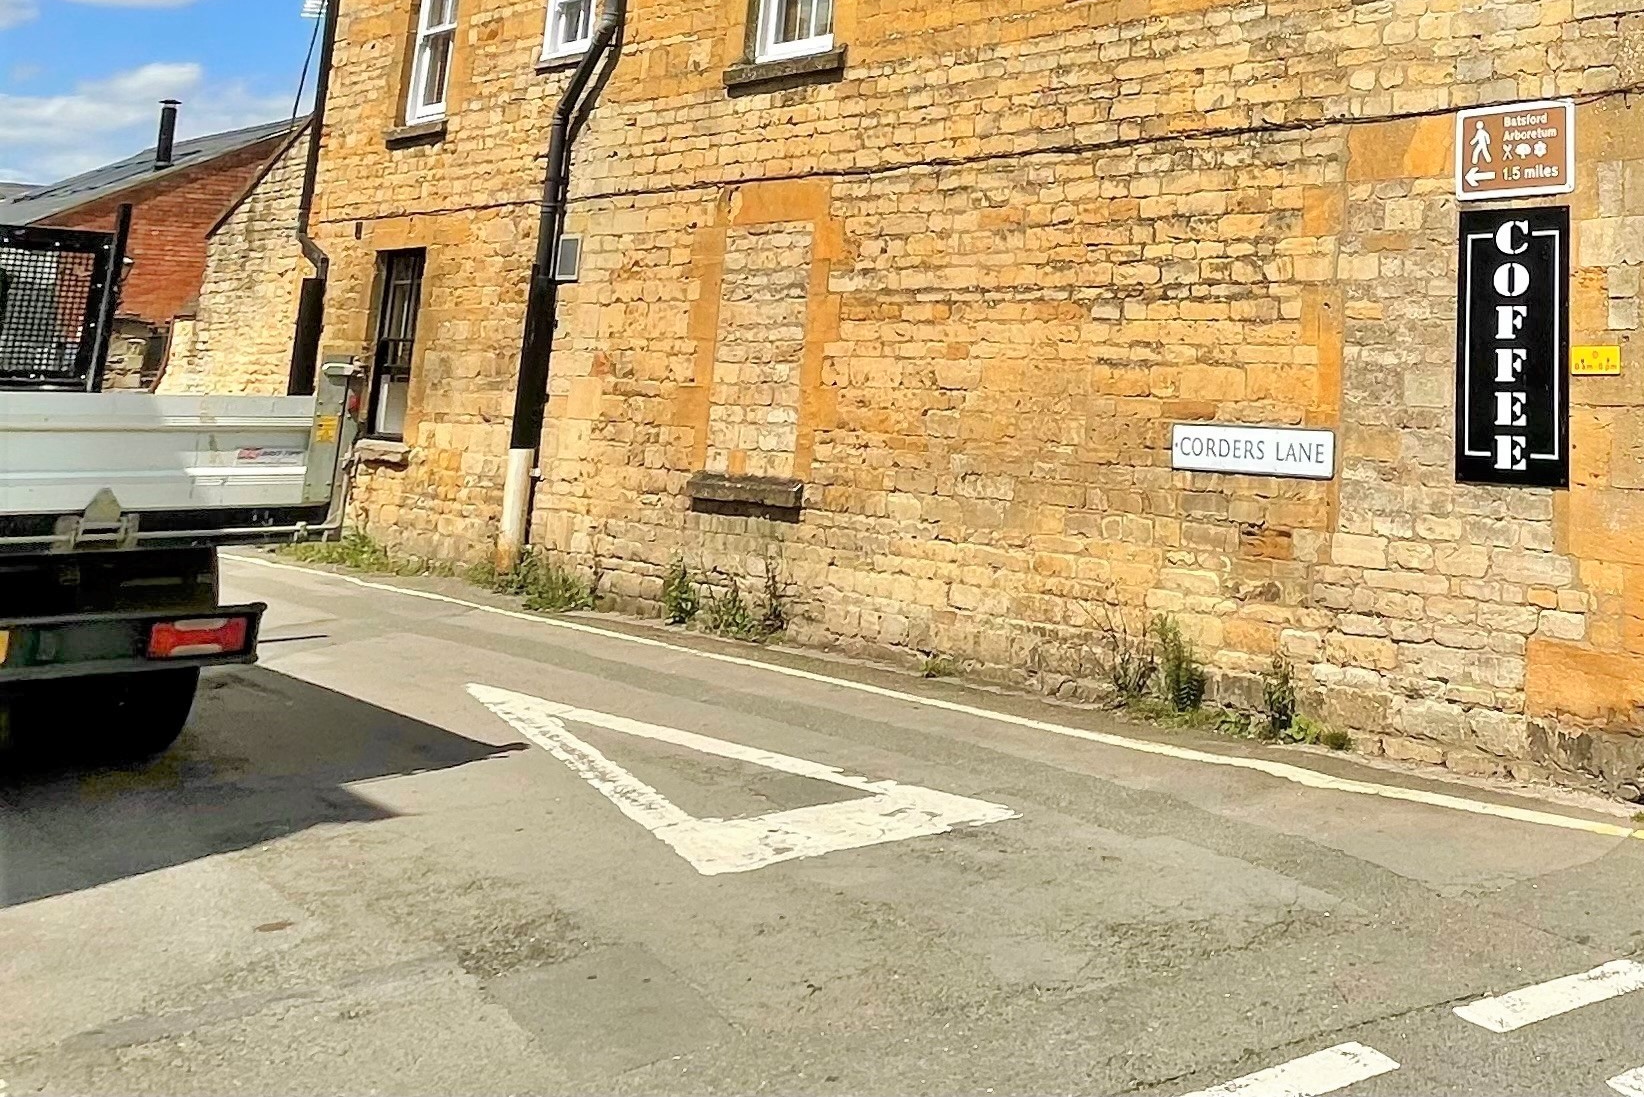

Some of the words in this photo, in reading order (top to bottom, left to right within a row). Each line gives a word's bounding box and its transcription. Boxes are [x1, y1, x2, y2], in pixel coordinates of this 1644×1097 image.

[1503, 112, 1548, 128] Batsford
[1502, 127, 1558, 142] Arboretum
[1502, 165, 1521, 180] 1.5
[1524, 163, 1559, 179] miles
[1493, 220, 1530, 470] COFFEE
[1180, 436, 1265, 460] CORDERS
[1275, 441, 1325, 464] LANE
